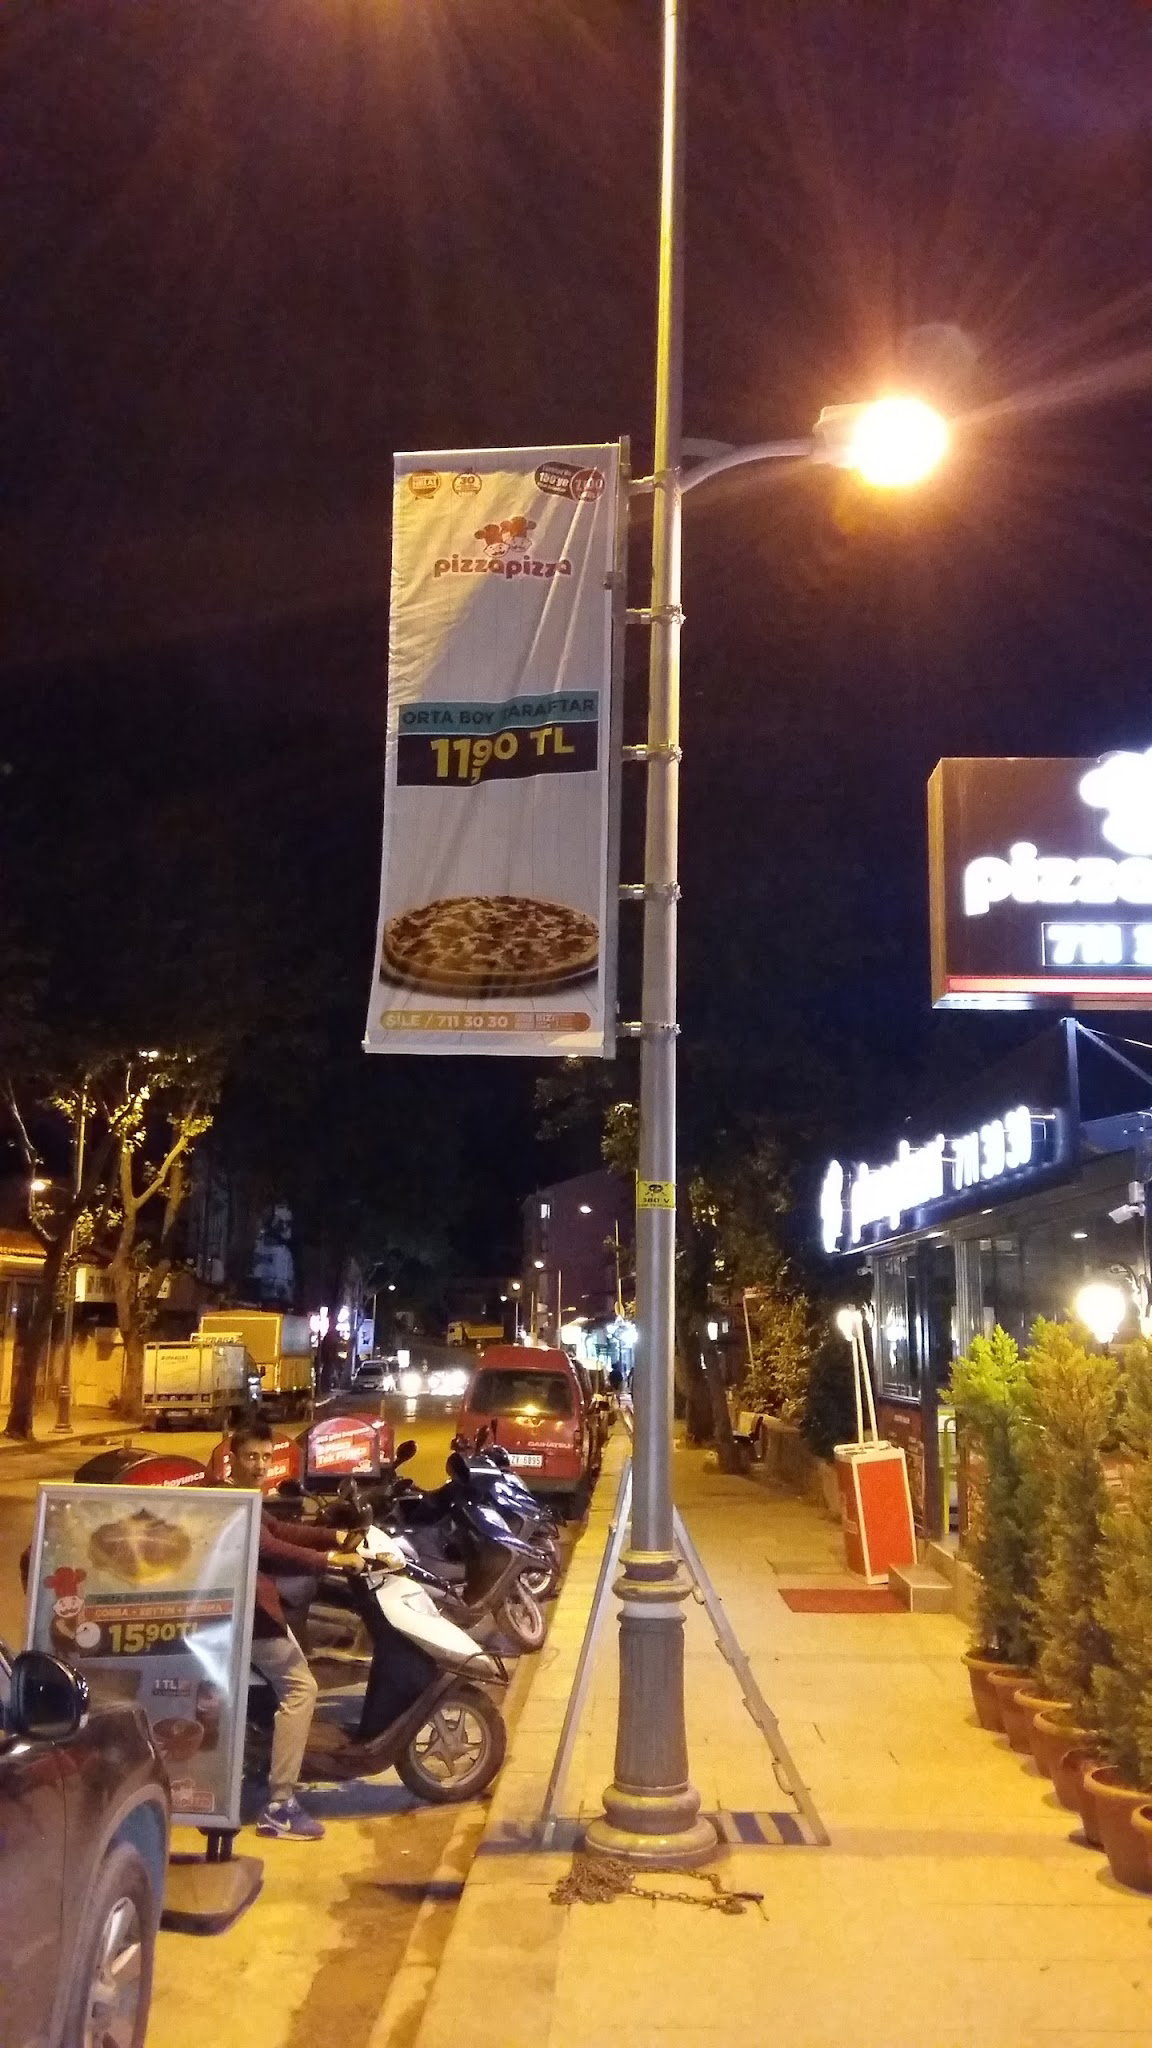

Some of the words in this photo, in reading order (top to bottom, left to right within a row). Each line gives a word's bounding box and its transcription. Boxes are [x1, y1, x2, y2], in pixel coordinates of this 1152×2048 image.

[434, 555, 571, 578] pizzapizza
[403, 711, 454, 724] ORTA
[459, 711, 495, 723] BOY
[430, 732, 519, 784] 11,90
[530, 727, 575, 756] TL
[438, 1015, 459, 1027] 711
[464, 1015, 483, 1027] 30
[488, 1016, 507, 1028] 30
